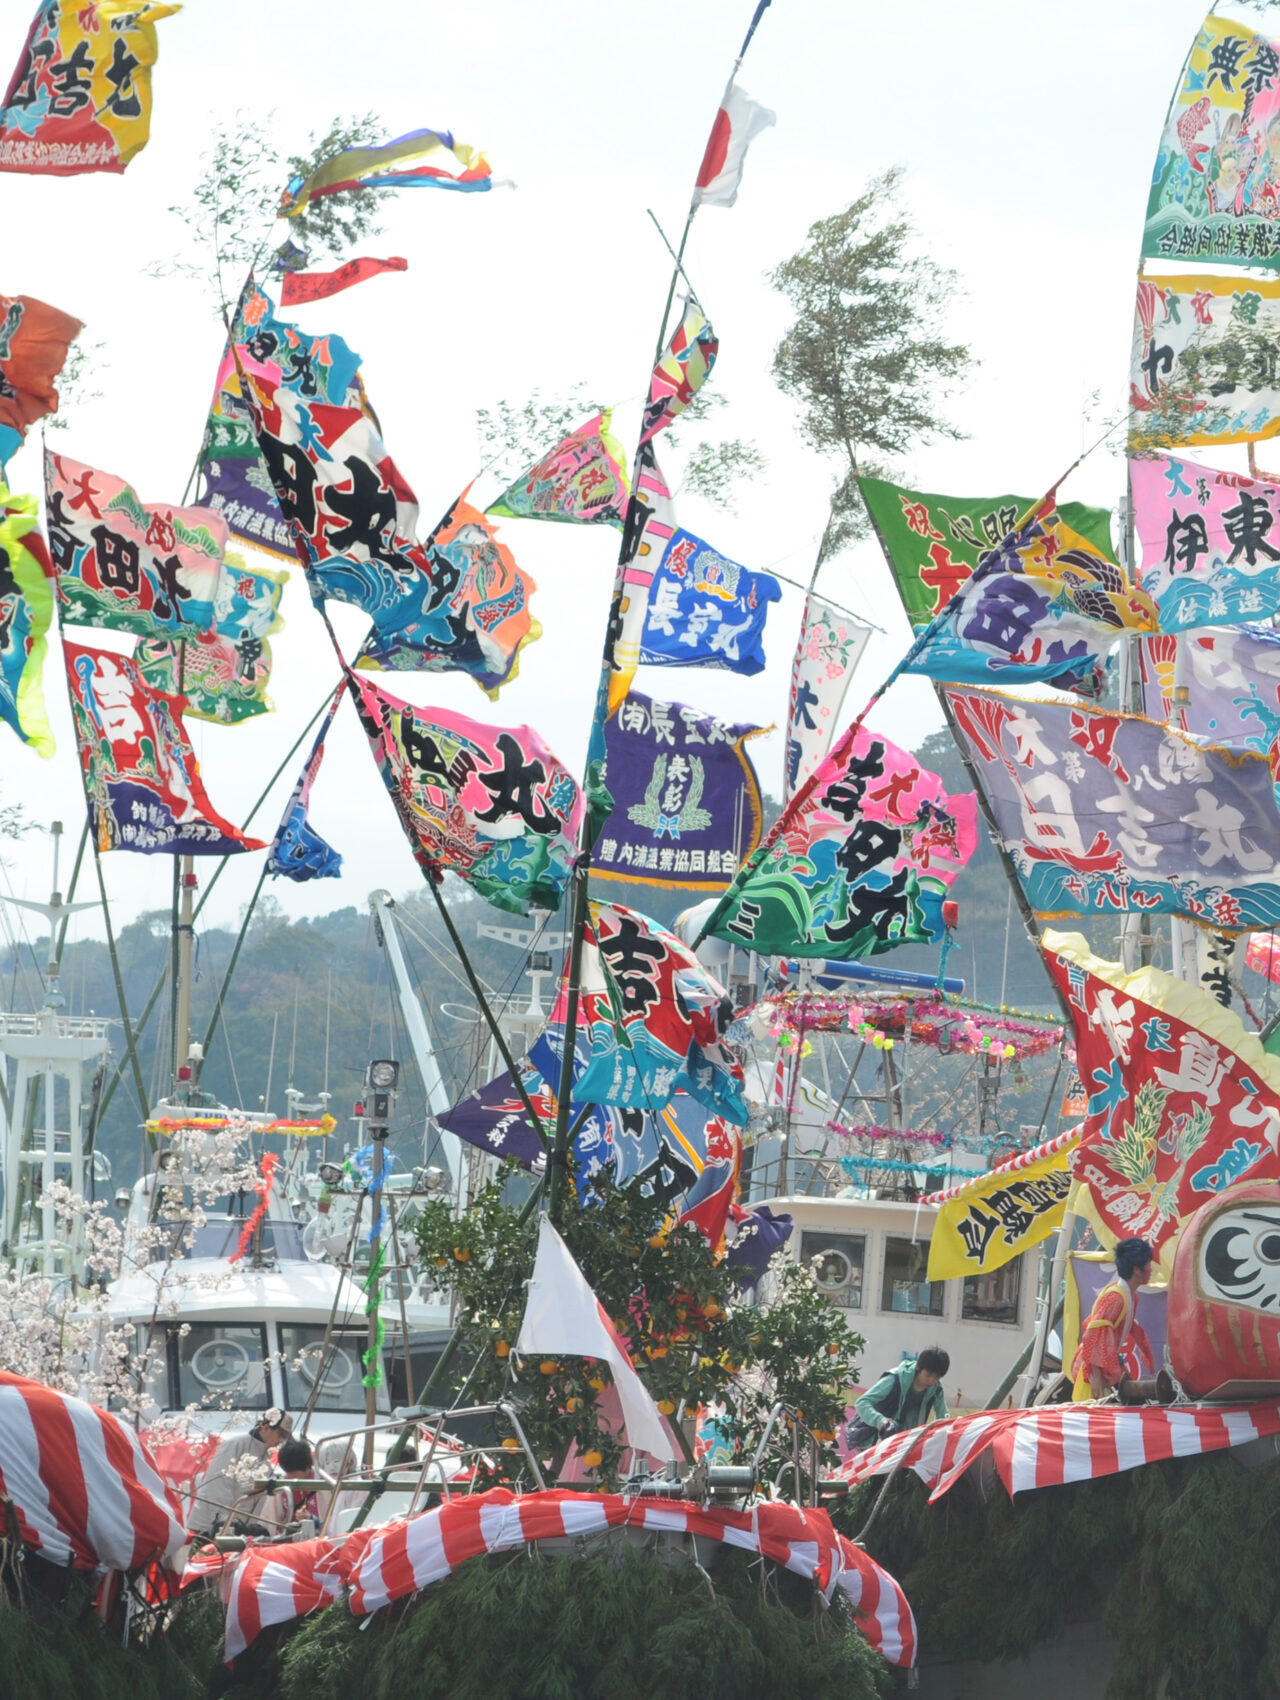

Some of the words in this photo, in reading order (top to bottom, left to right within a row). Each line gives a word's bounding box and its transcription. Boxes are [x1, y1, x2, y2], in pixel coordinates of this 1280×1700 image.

[68, 469, 103, 520] 大
[1164, 456, 1193, 499] 大
[898, 495, 946, 540] 祝
[660, 754, 691, 812] 表彰
[600, 838, 738, 874] 贈内浦漁業協同組合
